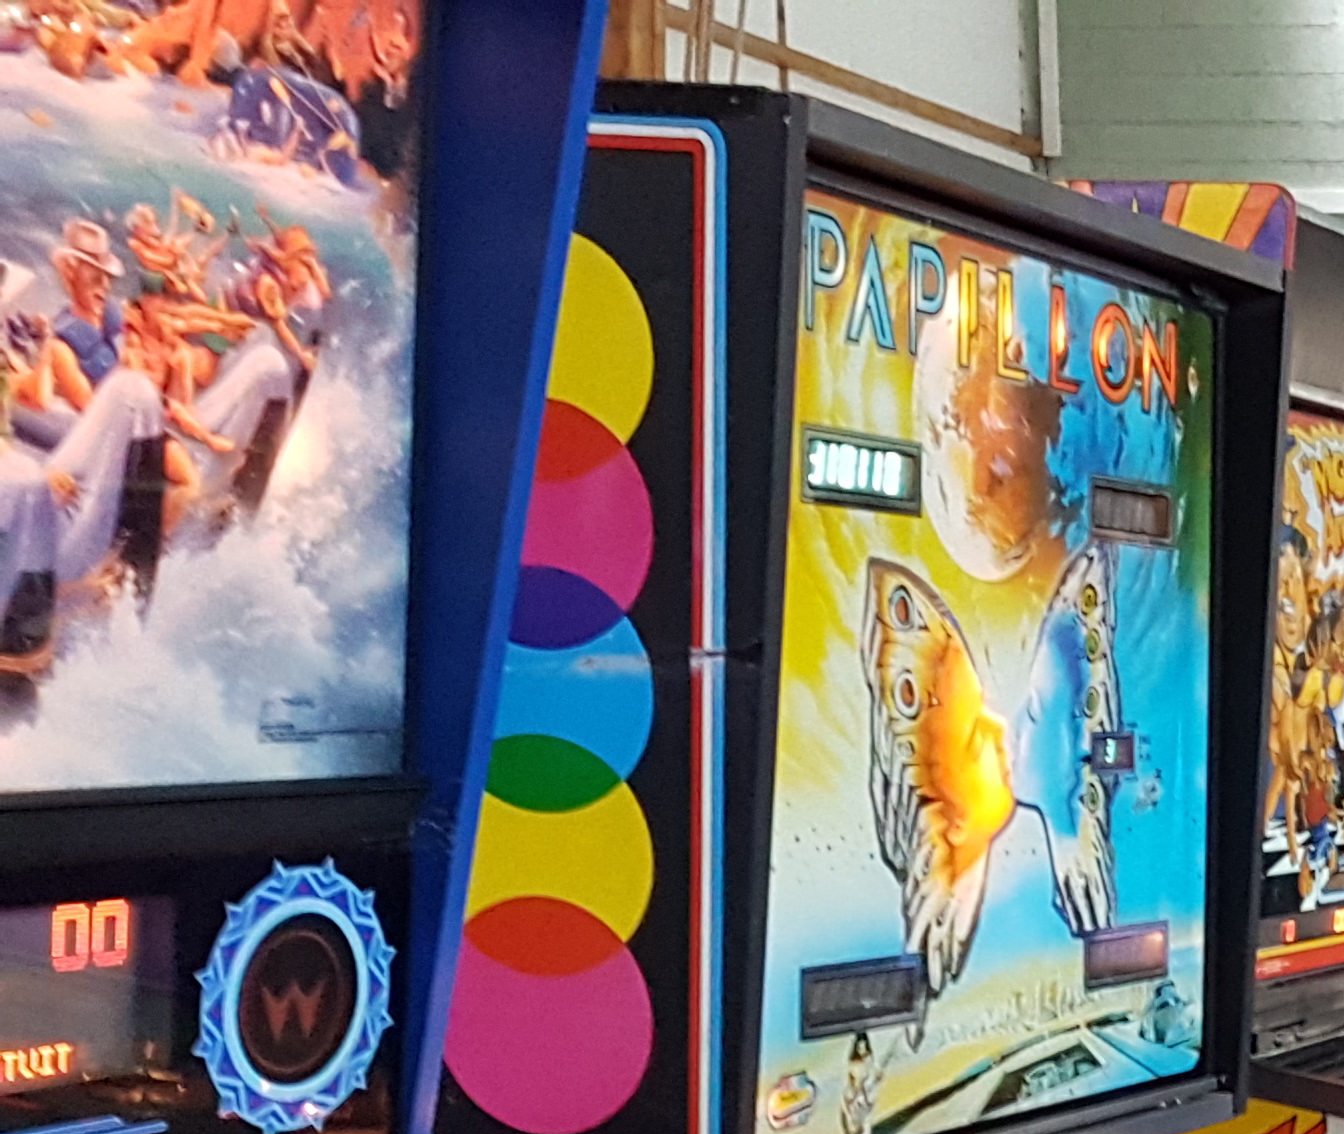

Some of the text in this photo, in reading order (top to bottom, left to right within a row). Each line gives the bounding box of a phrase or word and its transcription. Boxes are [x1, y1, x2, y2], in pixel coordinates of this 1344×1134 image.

[804, 209, 1180, 414] PAPILLON
[51, 898, 130, 973] 00
[0, 1041, 75, 1083] TUIT
